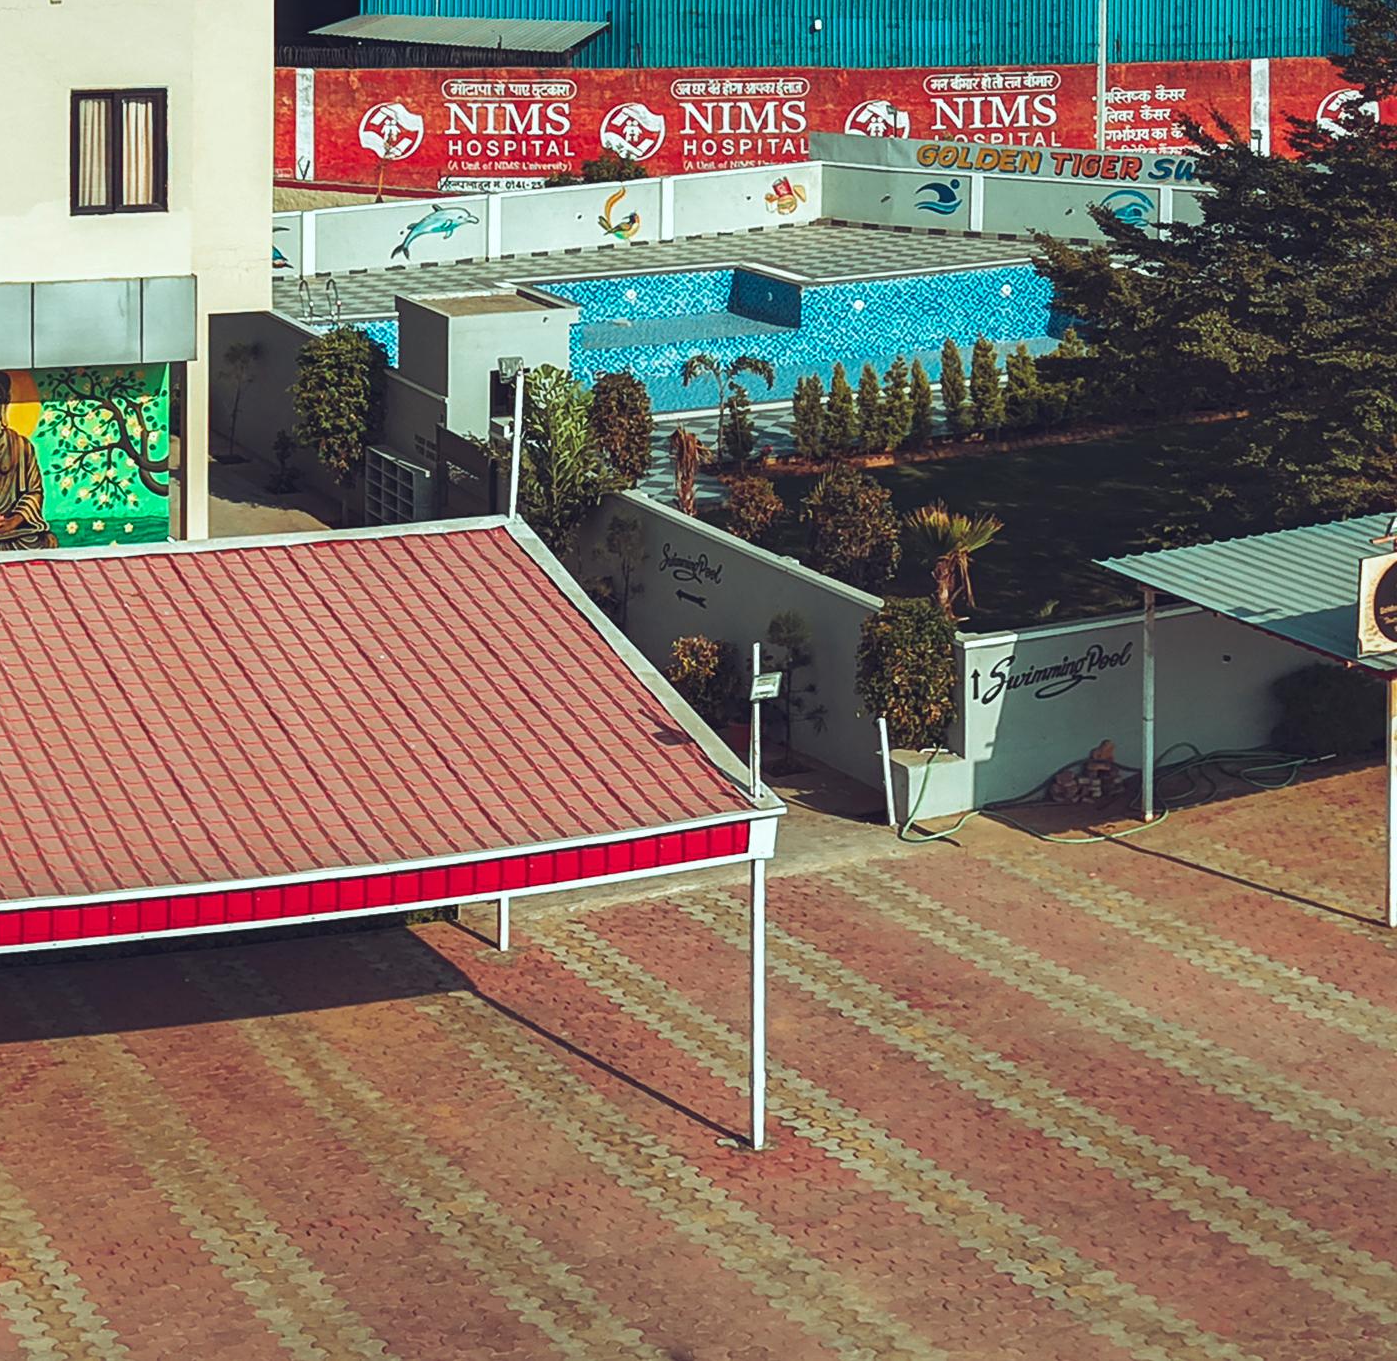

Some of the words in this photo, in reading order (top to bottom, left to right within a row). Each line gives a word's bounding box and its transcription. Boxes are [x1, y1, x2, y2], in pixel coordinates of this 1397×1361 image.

[443, 102, 571, 136] NIMS
[679, 100, 807, 134] NIMS
[930, 94, 1057, 130] NIMS
[448, 139, 576, 157] HOSPITAL
[683, 138, 809, 156] HOSPITAL
[917, 144, 1042, 174] GOLDEN
[1050, 152, 1142, 181] TIGER
[461, 160, 481, 170] Unit
[482, 160, 492, 170] of
[494, 161, 520, 170] NIMS
[981, 655, 1097, 705] Swimming
[1086, 642, 1134, 674] Pool
